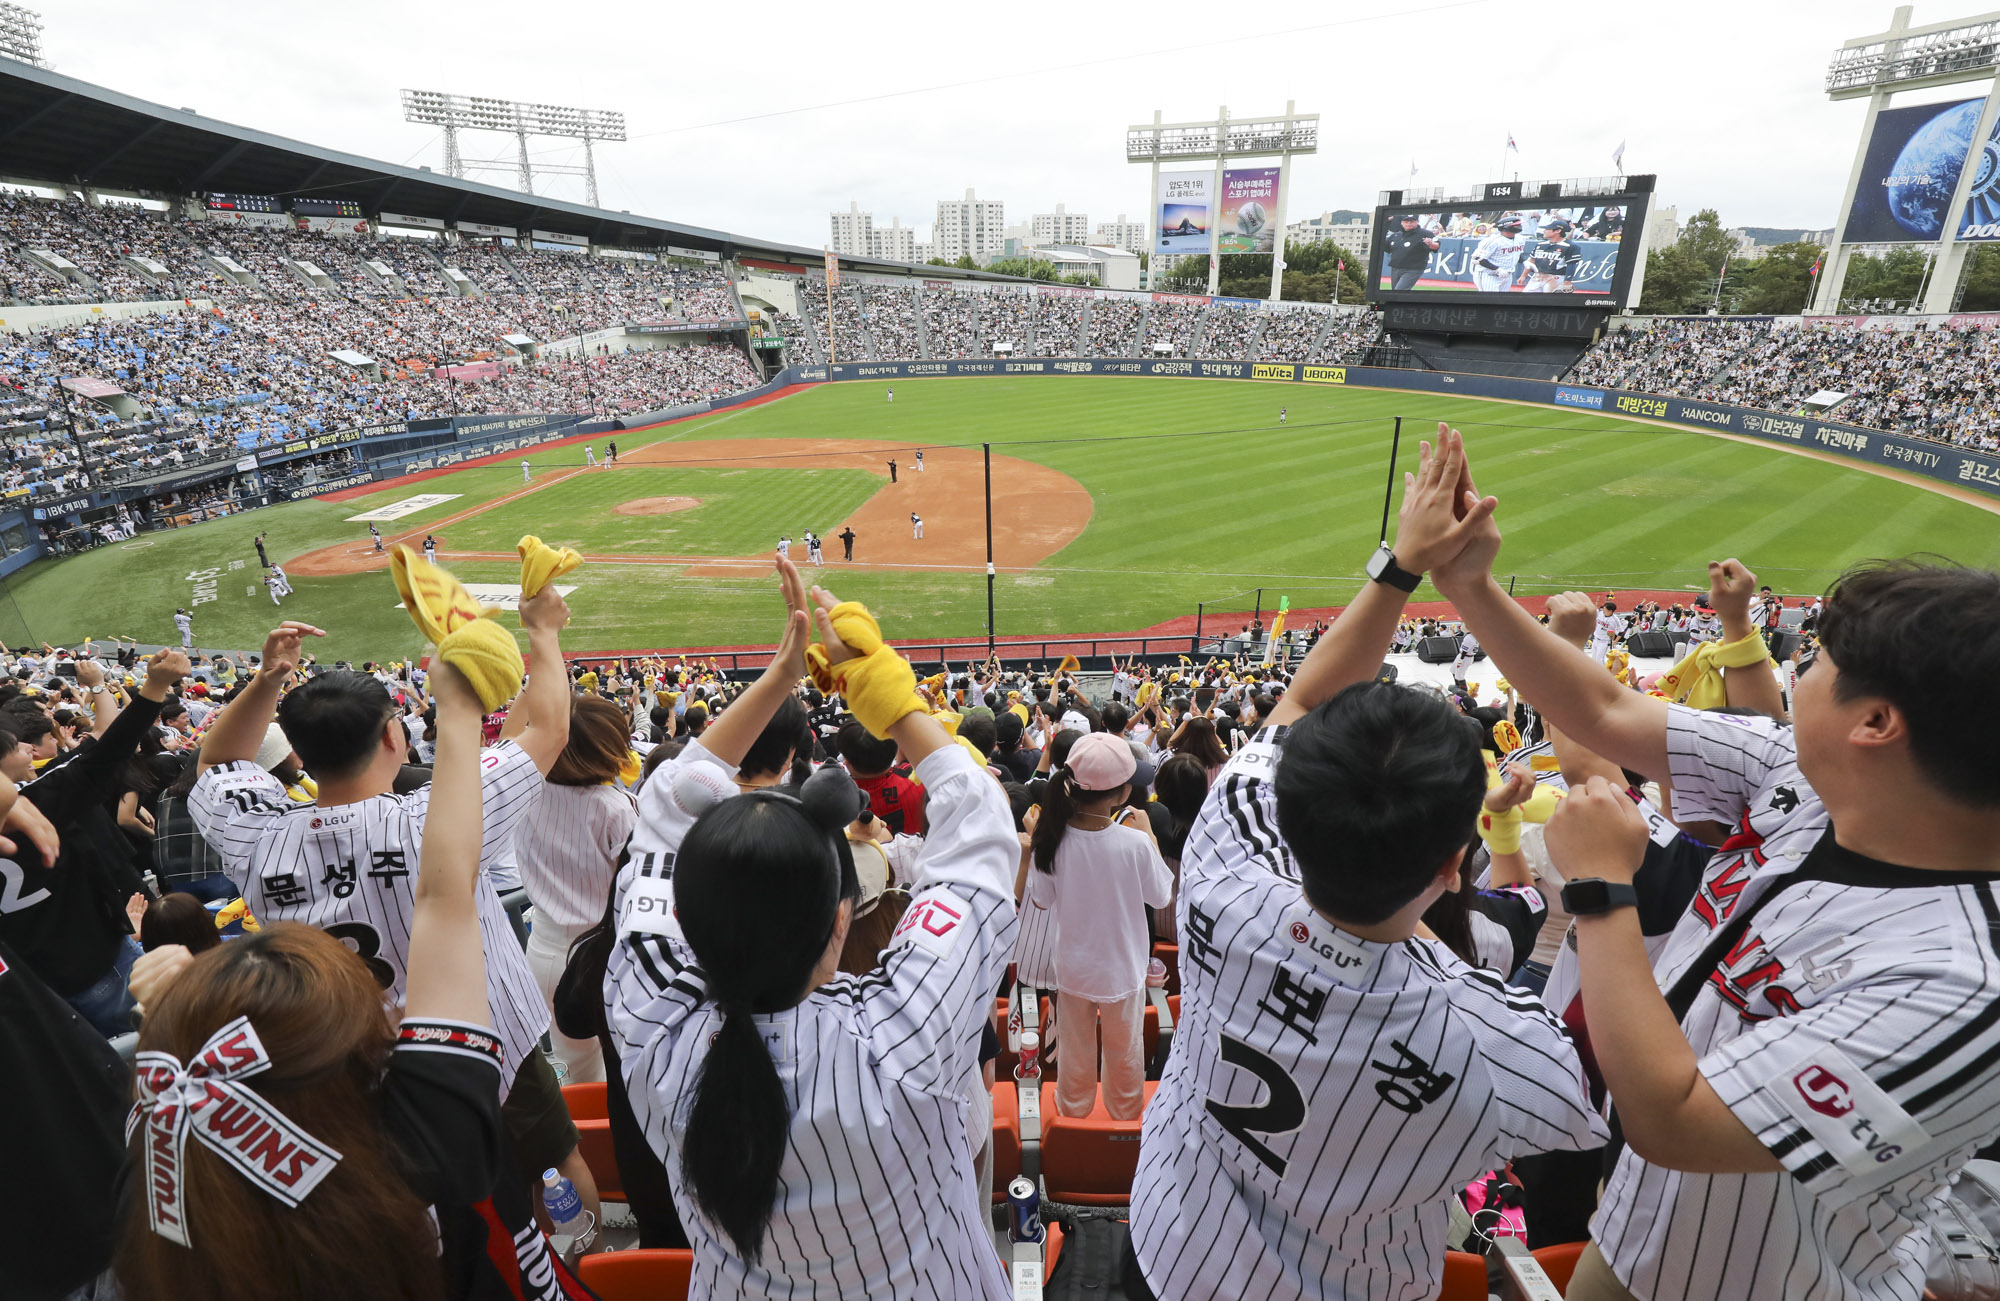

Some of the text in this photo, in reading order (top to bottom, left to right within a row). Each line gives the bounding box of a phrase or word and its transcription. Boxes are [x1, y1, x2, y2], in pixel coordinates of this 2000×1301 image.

[1169, 180, 1204, 190] 압도적 1위
[1492, 186, 1511, 196] 15:54
[1881, 175, 1910, 188] 내일의
[1177, 189, 1194, 198] 올레드
[1250, 189, 1271, 198] 앱에서
[1391, 306, 1480, 329] 한국경제신문
[1494, 312, 1590, 332] 한국경제TV
[858, 366, 898, 376] BNK 캐피탈
[957, 364, 995, 372] 한국경제신문
[1119, 363, 1142, 372] 비타란
[1165, 362, 1192, 374] 금강주택
[1201, 363, 1243, 376] 현대해상
[1253, 365, 1292, 378] I'mVita
[1304, 368, 1344, 381] UBORA
[1564, 390, 1602, 406] 도미노피자
[1616, 396, 1668, 417] 대방건설
[458, 415, 547, 436] 공공기관 이사가자! 충남혁신도시
[1681, 407, 1732, 425] HANCOM
[1761, 417, 1805, 439] 대보건설
[1815, 426, 1869, 452] 치킨마루
[1883, 443, 1942, 468] 한국경제TV
[300, 485, 319, 497] 금강주택
[356, 472, 373, 483] 금강주택
[324, 815, 339, 827] LG
[263, 851, 410, 907] 문성주
[637, 896, 668, 916] LG
[1308, 935, 1336, 961] LG
[1184, 902, 1456, 1115] 문보경
[1203, 1029, 1310, 1182] 2
[188, 1080, 320, 1188] TWINS
[150, 1100, 179, 1227] TWINS
